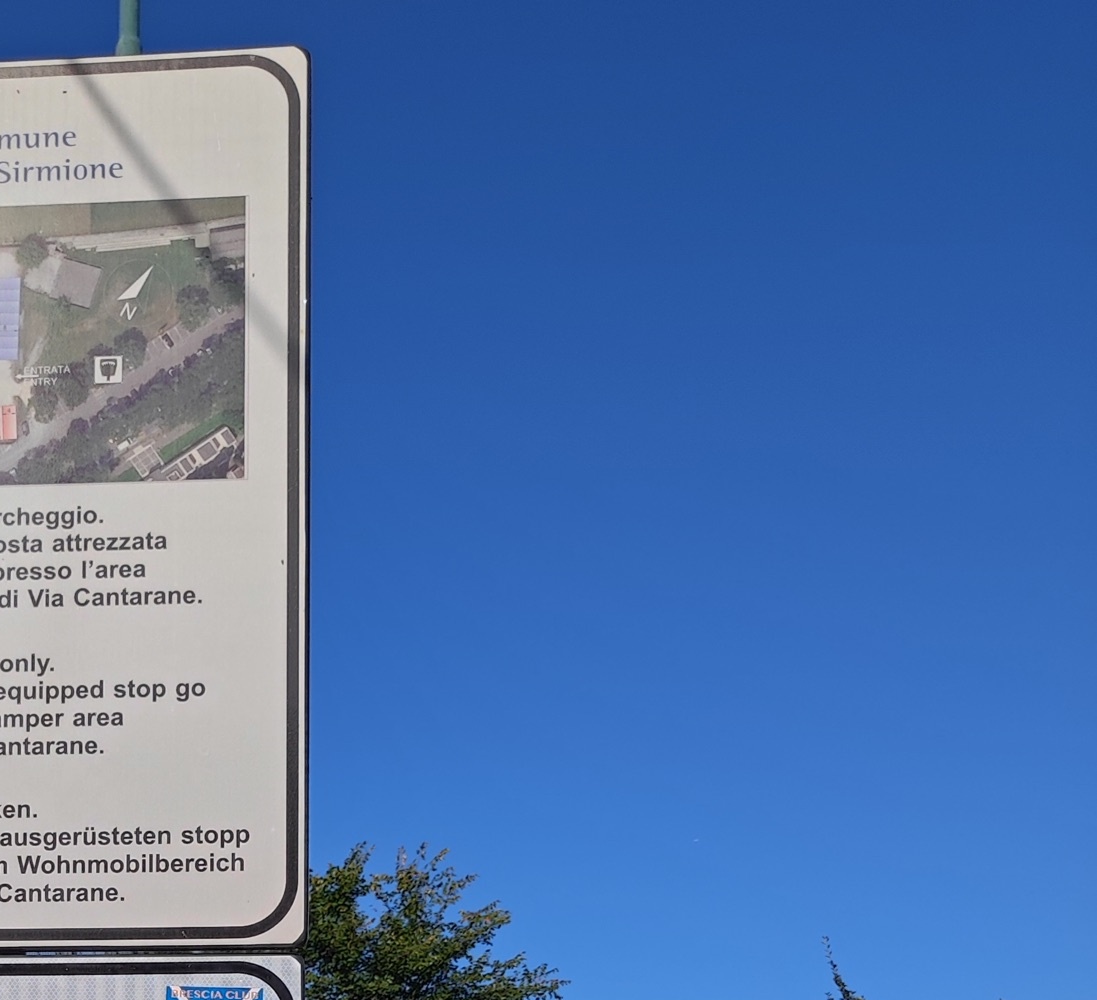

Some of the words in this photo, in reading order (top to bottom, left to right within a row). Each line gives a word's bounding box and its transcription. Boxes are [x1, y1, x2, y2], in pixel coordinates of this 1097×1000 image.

[119, 302, 137, 320] N
[24, 365, 71, 375] ENTRATA
[51, 531, 168, 553] attrezzata
[27, 588, 65, 608] Via
[73, 587, 203, 608] Cantarane.
[0, 652, 55, 678] only.
[113, 679, 167, 703] stop
[175, 682, 206, 703] go
[72, 711, 124, 728] area
[0, 826, 172, 852] ausgerüsteten
[180, 825, 251, 849] stopp
[16, 852, 245, 875] Wohnmobilbereich
